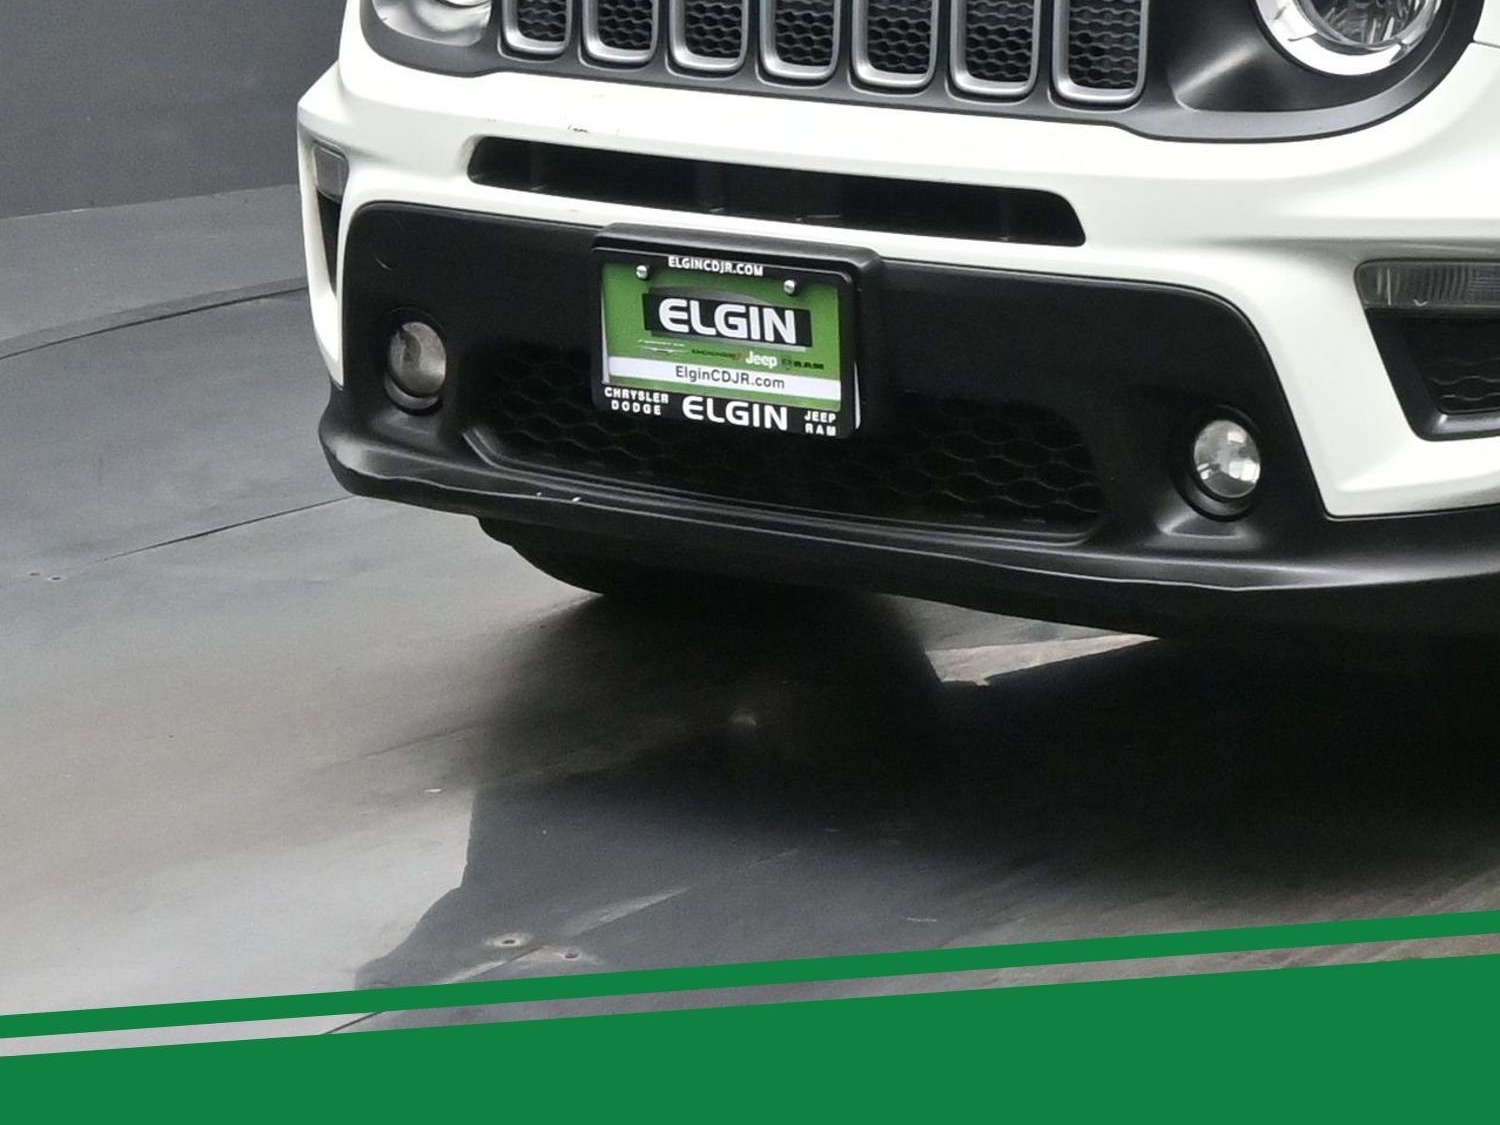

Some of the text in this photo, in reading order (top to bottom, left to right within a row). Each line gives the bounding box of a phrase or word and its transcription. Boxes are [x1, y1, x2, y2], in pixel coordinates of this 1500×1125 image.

[668, 256, 764, 277] ELGINCDJR.COM
[658, 297, 798, 345] ELGIN
[745, 350, 778, 369] Jeep
[675, 365, 786, 390] ElginCDJR.com
[604, 386, 669, 404] CHRYSLER
[611, 401, 662, 416] DODGE
[682, 395, 788, 431] ELGIN
[804, 410, 836, 424] JEEP
[805, 423, 836, 437] RAM
